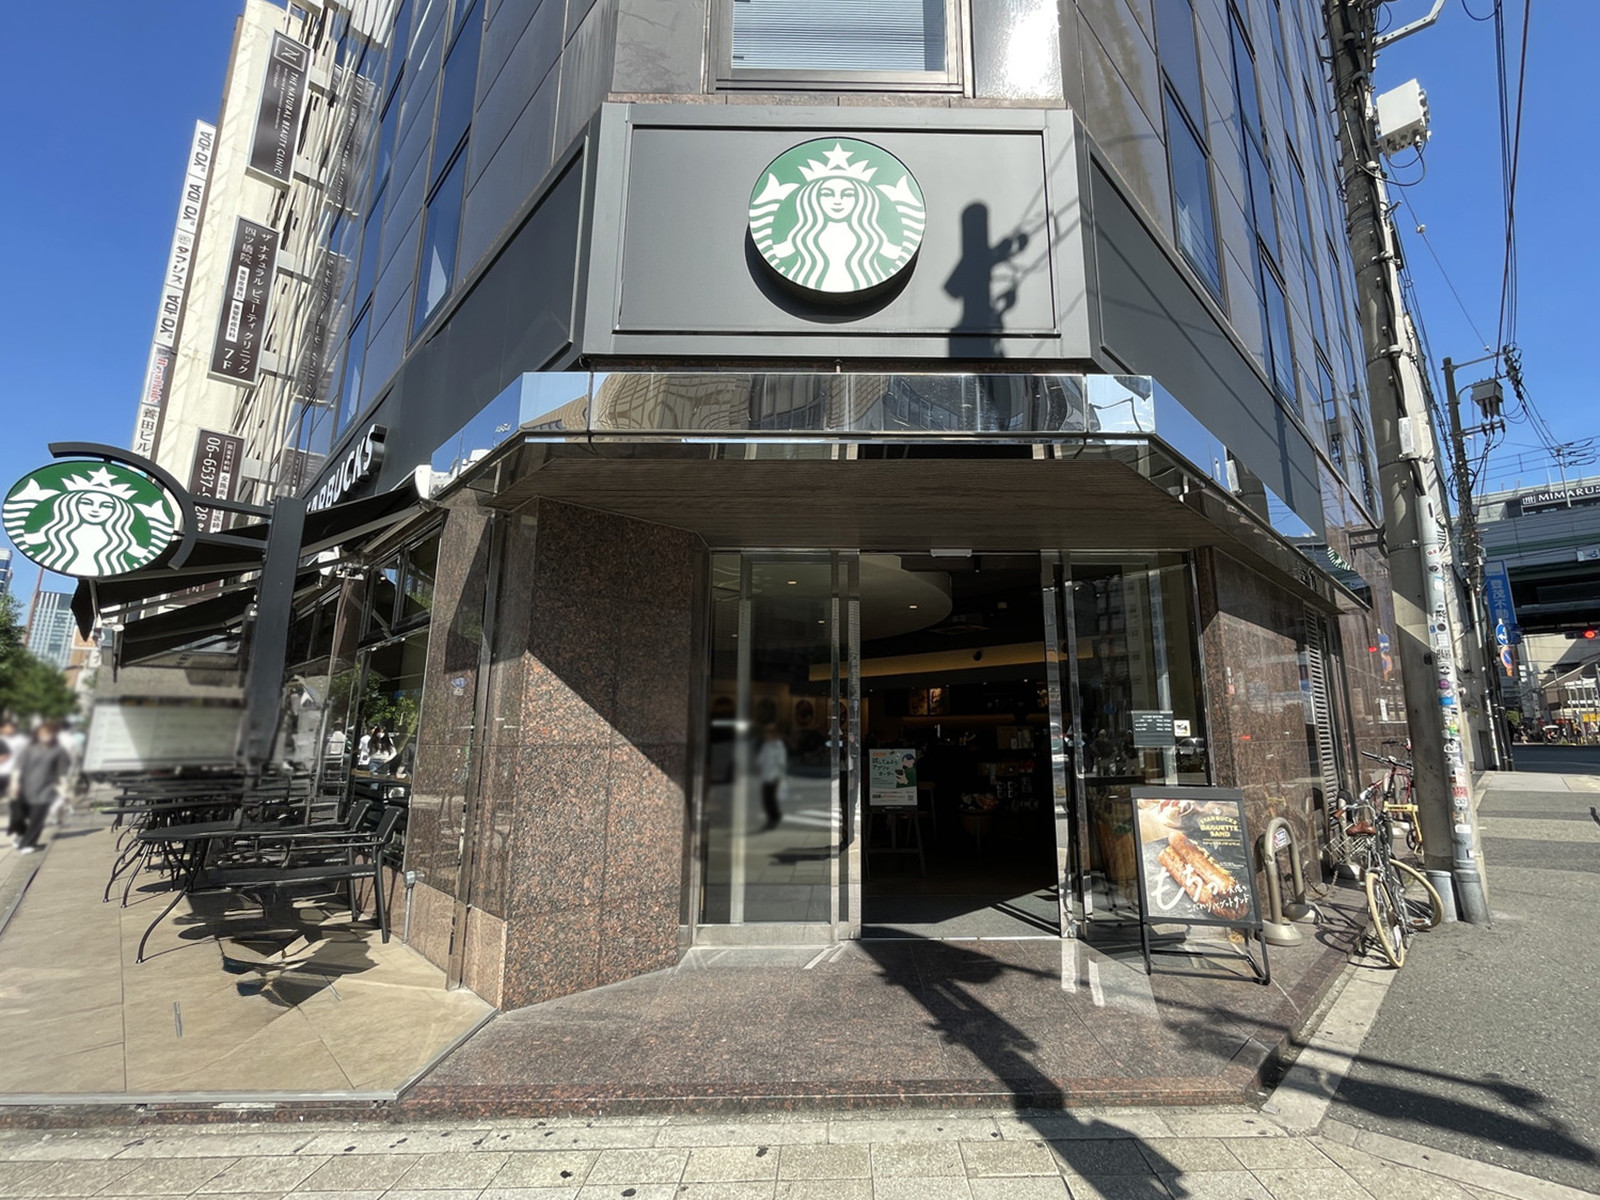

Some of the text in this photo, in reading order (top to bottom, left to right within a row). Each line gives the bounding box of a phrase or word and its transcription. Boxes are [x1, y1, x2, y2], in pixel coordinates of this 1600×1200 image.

[290, 71, 299, 87] THE
[283, 85, 296, 120] NATURAL
[278, 119, 290, 148] BEAUTY
[273, 147, 285, 175] CLINIC
[1538, 486, 1594, 502] MIMARU
[1200, 824, 1239, 832] BAGUETTE
